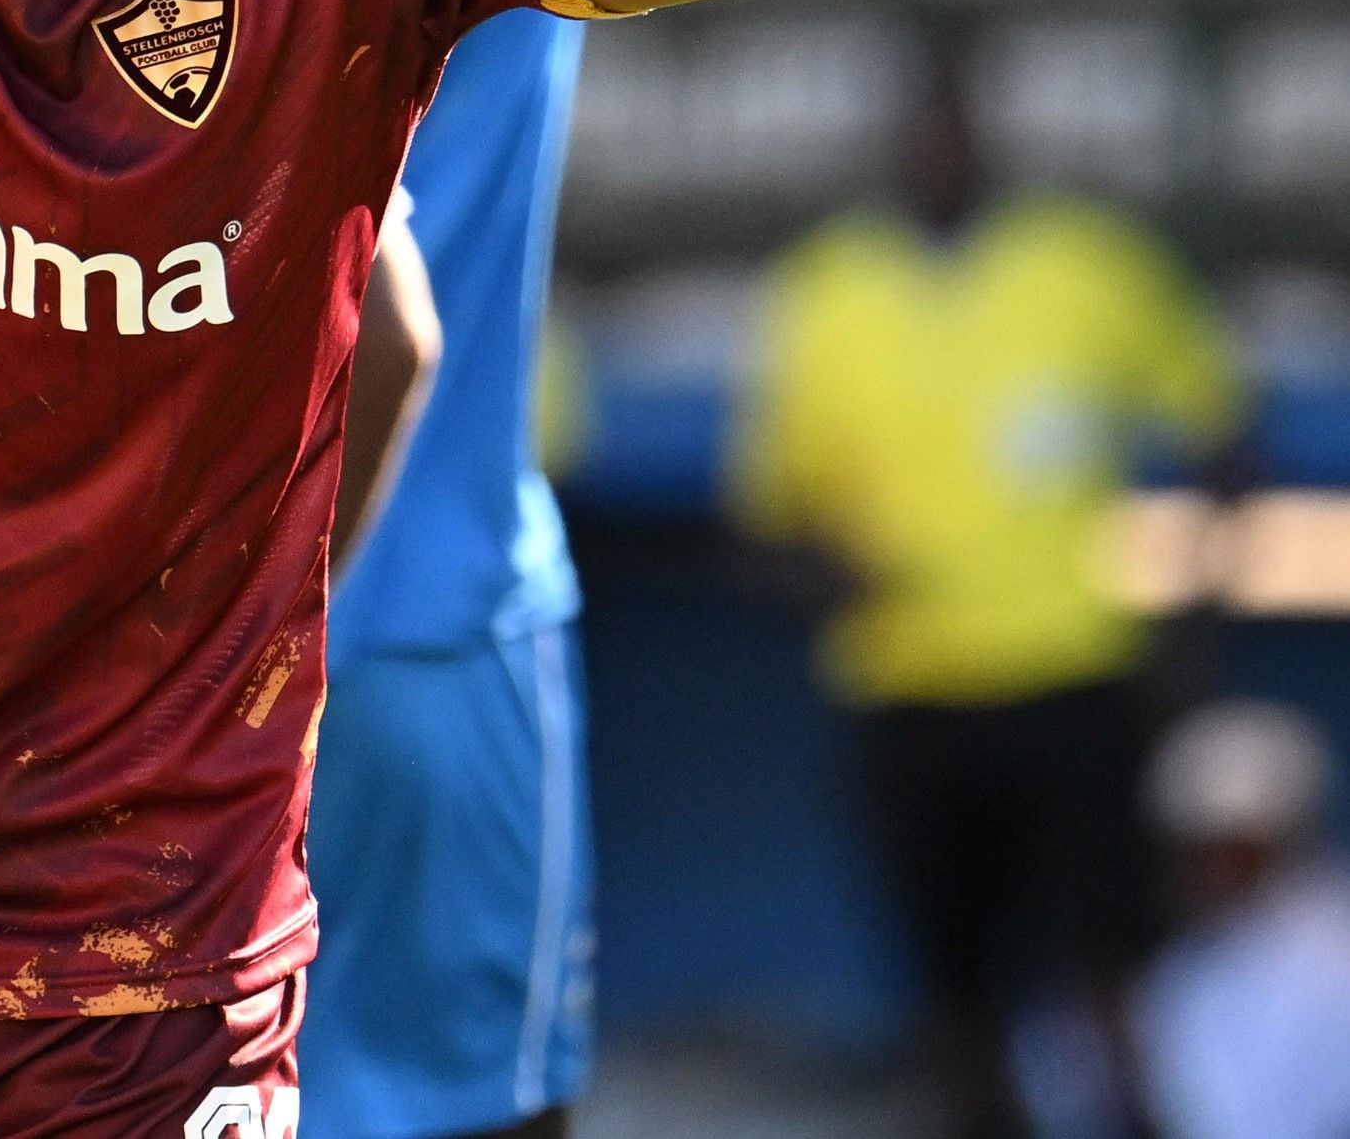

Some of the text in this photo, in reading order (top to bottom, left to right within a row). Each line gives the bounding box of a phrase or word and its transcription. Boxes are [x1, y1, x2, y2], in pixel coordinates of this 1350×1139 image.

[123, 21, 224, 55] STELLENBOSCH
[138, 38, 217, 66] FOOTBALL CLUB
